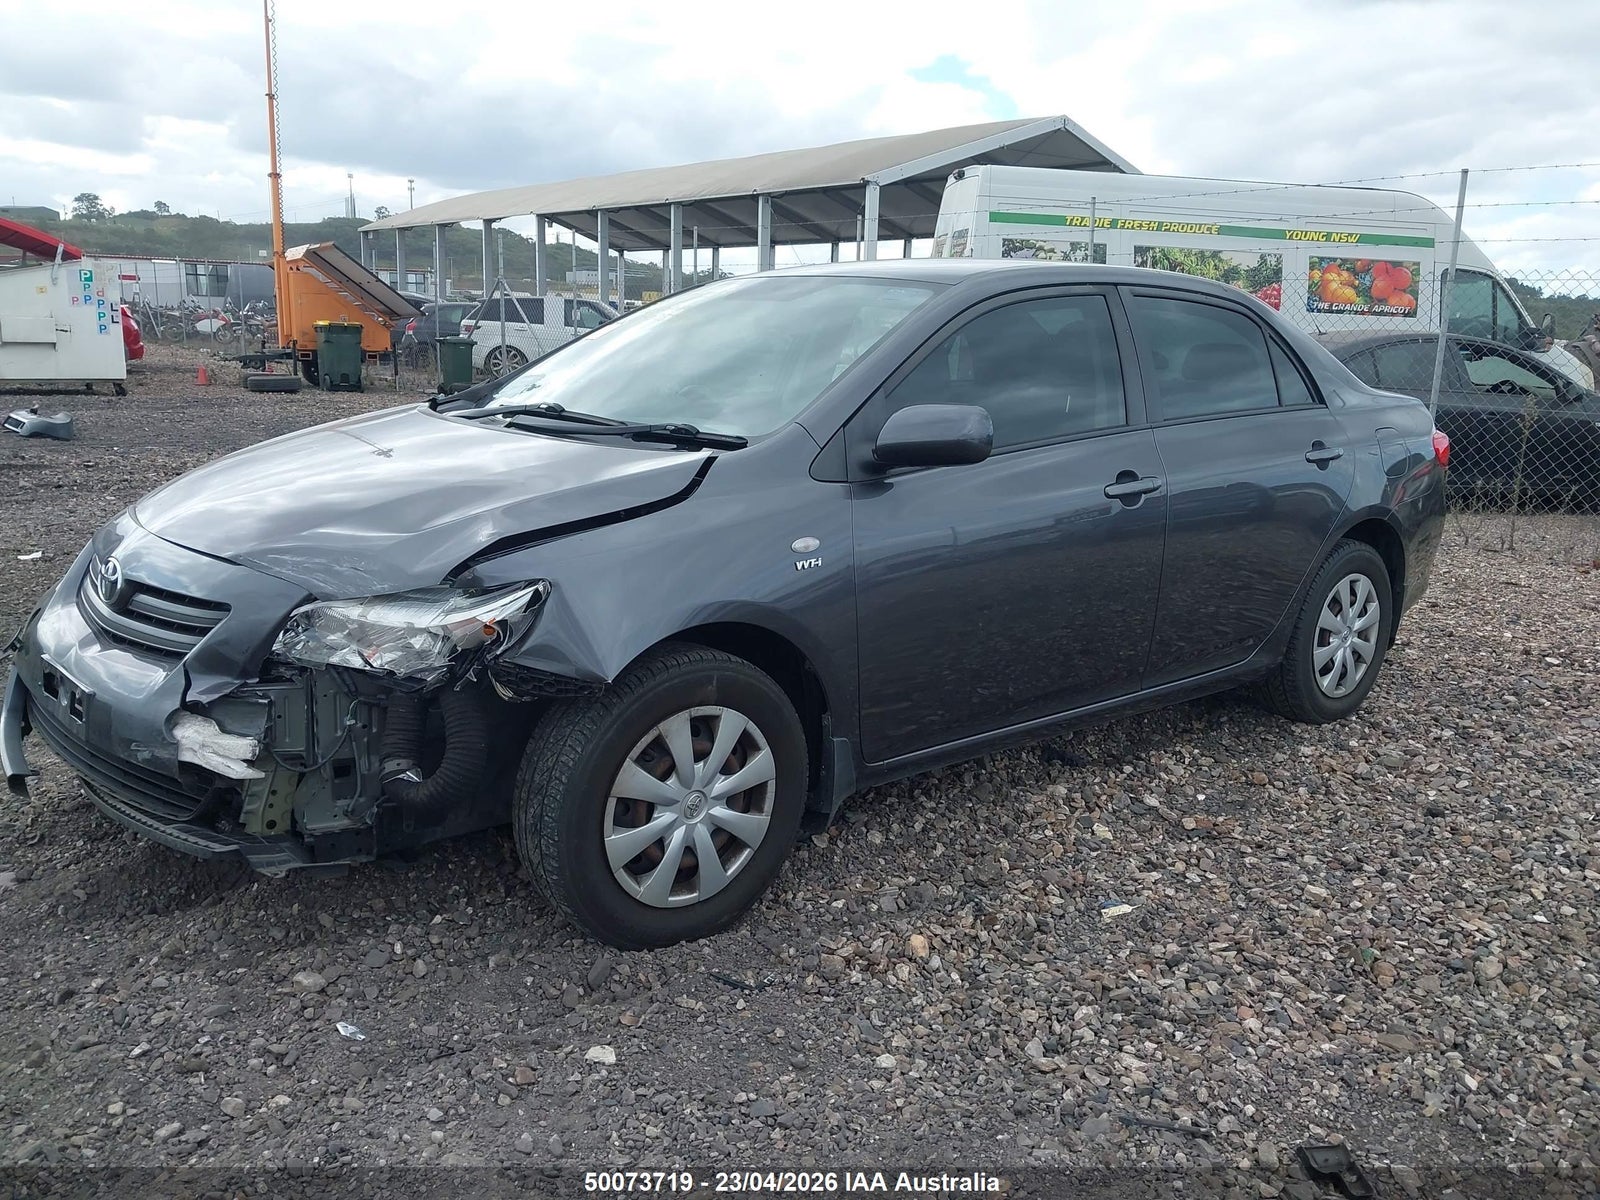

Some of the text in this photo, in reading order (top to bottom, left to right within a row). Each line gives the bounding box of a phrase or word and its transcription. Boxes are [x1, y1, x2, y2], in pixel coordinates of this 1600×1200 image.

[1116, 219, 1157, 231] FRESH
[1161, 222, 1220, 235] PRODUCE
[1284, 230, 1361, 244] YOUNG NSW
[1313, 301, 1411, 314] THE GRANDE APRICOT
